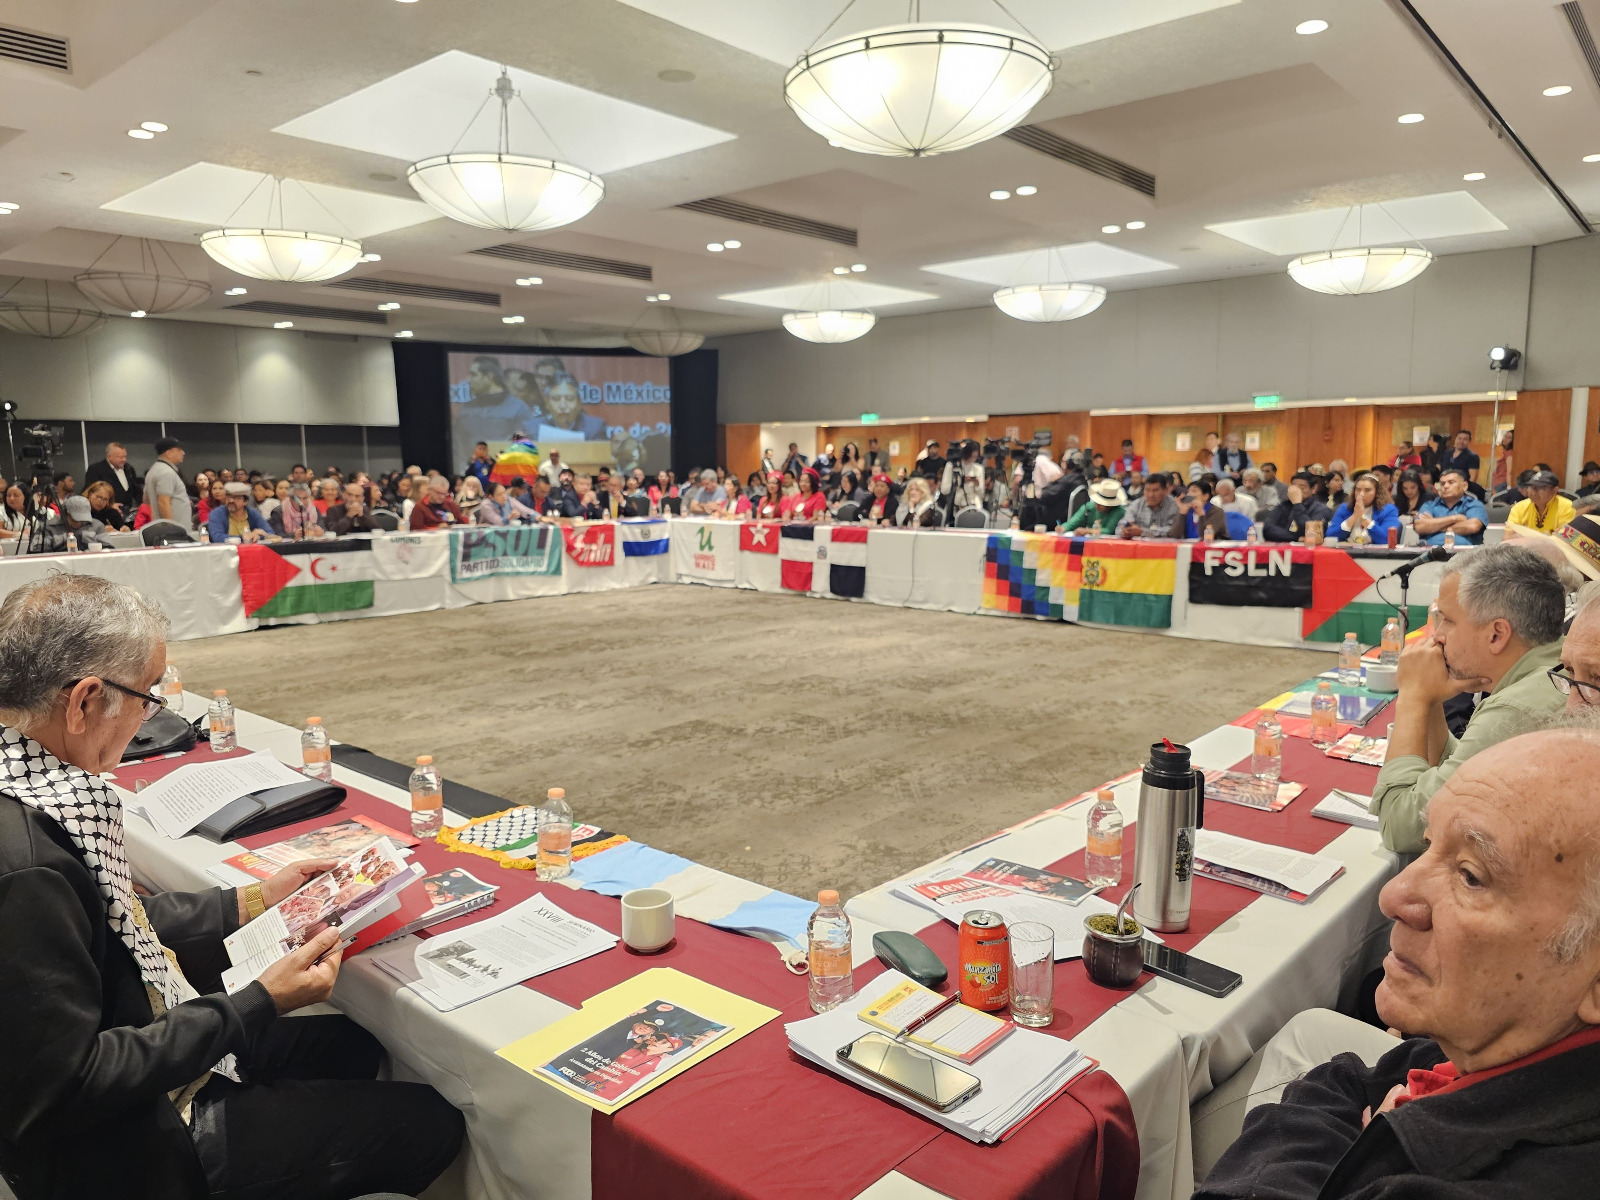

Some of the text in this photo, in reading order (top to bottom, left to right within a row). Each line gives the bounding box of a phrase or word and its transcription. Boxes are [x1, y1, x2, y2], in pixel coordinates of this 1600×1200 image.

[605, 383, 671, 402] México
[461, 558, 500, 574] PARTIDO
[1204, 549, 1292, 577] FSLN
